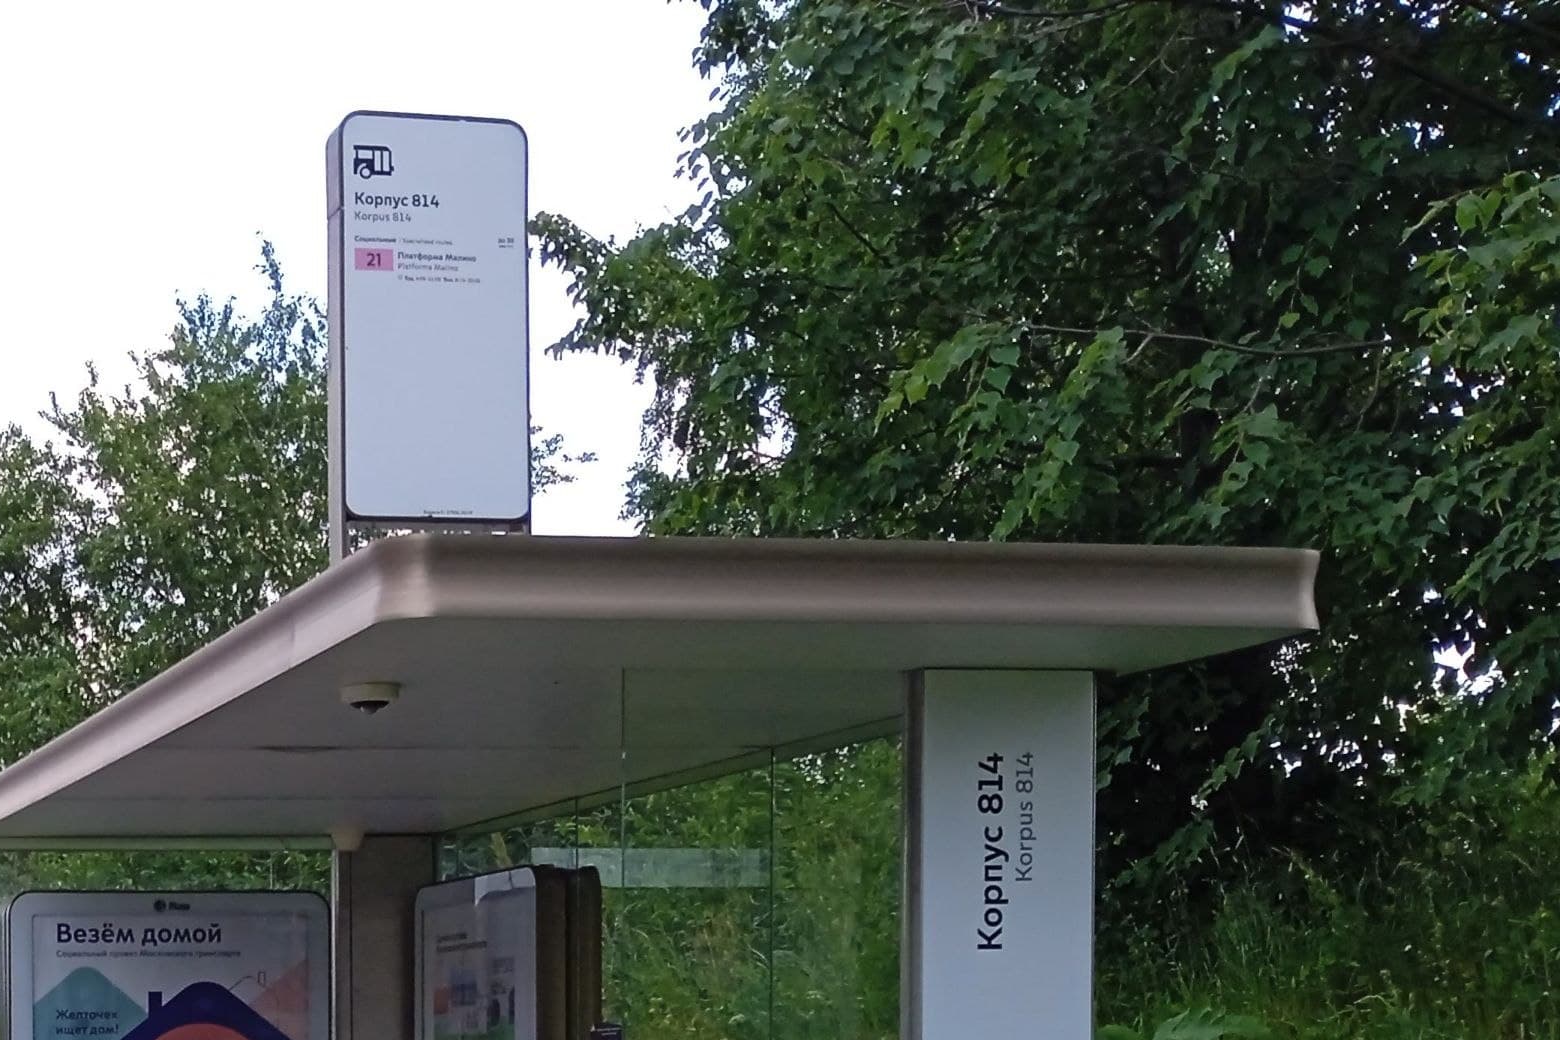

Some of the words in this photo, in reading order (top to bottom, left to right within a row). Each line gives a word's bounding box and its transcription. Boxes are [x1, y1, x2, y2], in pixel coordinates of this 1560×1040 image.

[354, 191, 409, 210] Корпус
[411, 193, 441, 209] 814
[354, 211, 391, 224] Korpus
[392, 212, 412, 223] 814
[366, 252, 383, 267] 21
[397, 251, 443, 263] Платформа
[444, 253, 477, 263] Малино
[1015, 751, 1034, 794] 814
[977, 752, 1004, 815] 814
[1015, 800, 1037, 882] Korpus
[977, 825, 1010, 950] Корпус
[56, 922, 135, 944] Везём
[141, 922, 223, 947] домой
[56, 1009, 118, 1023] Желточек
[55, 1025, 88, 1036] ищет
[89, 1023, 120, 1036] дом!
